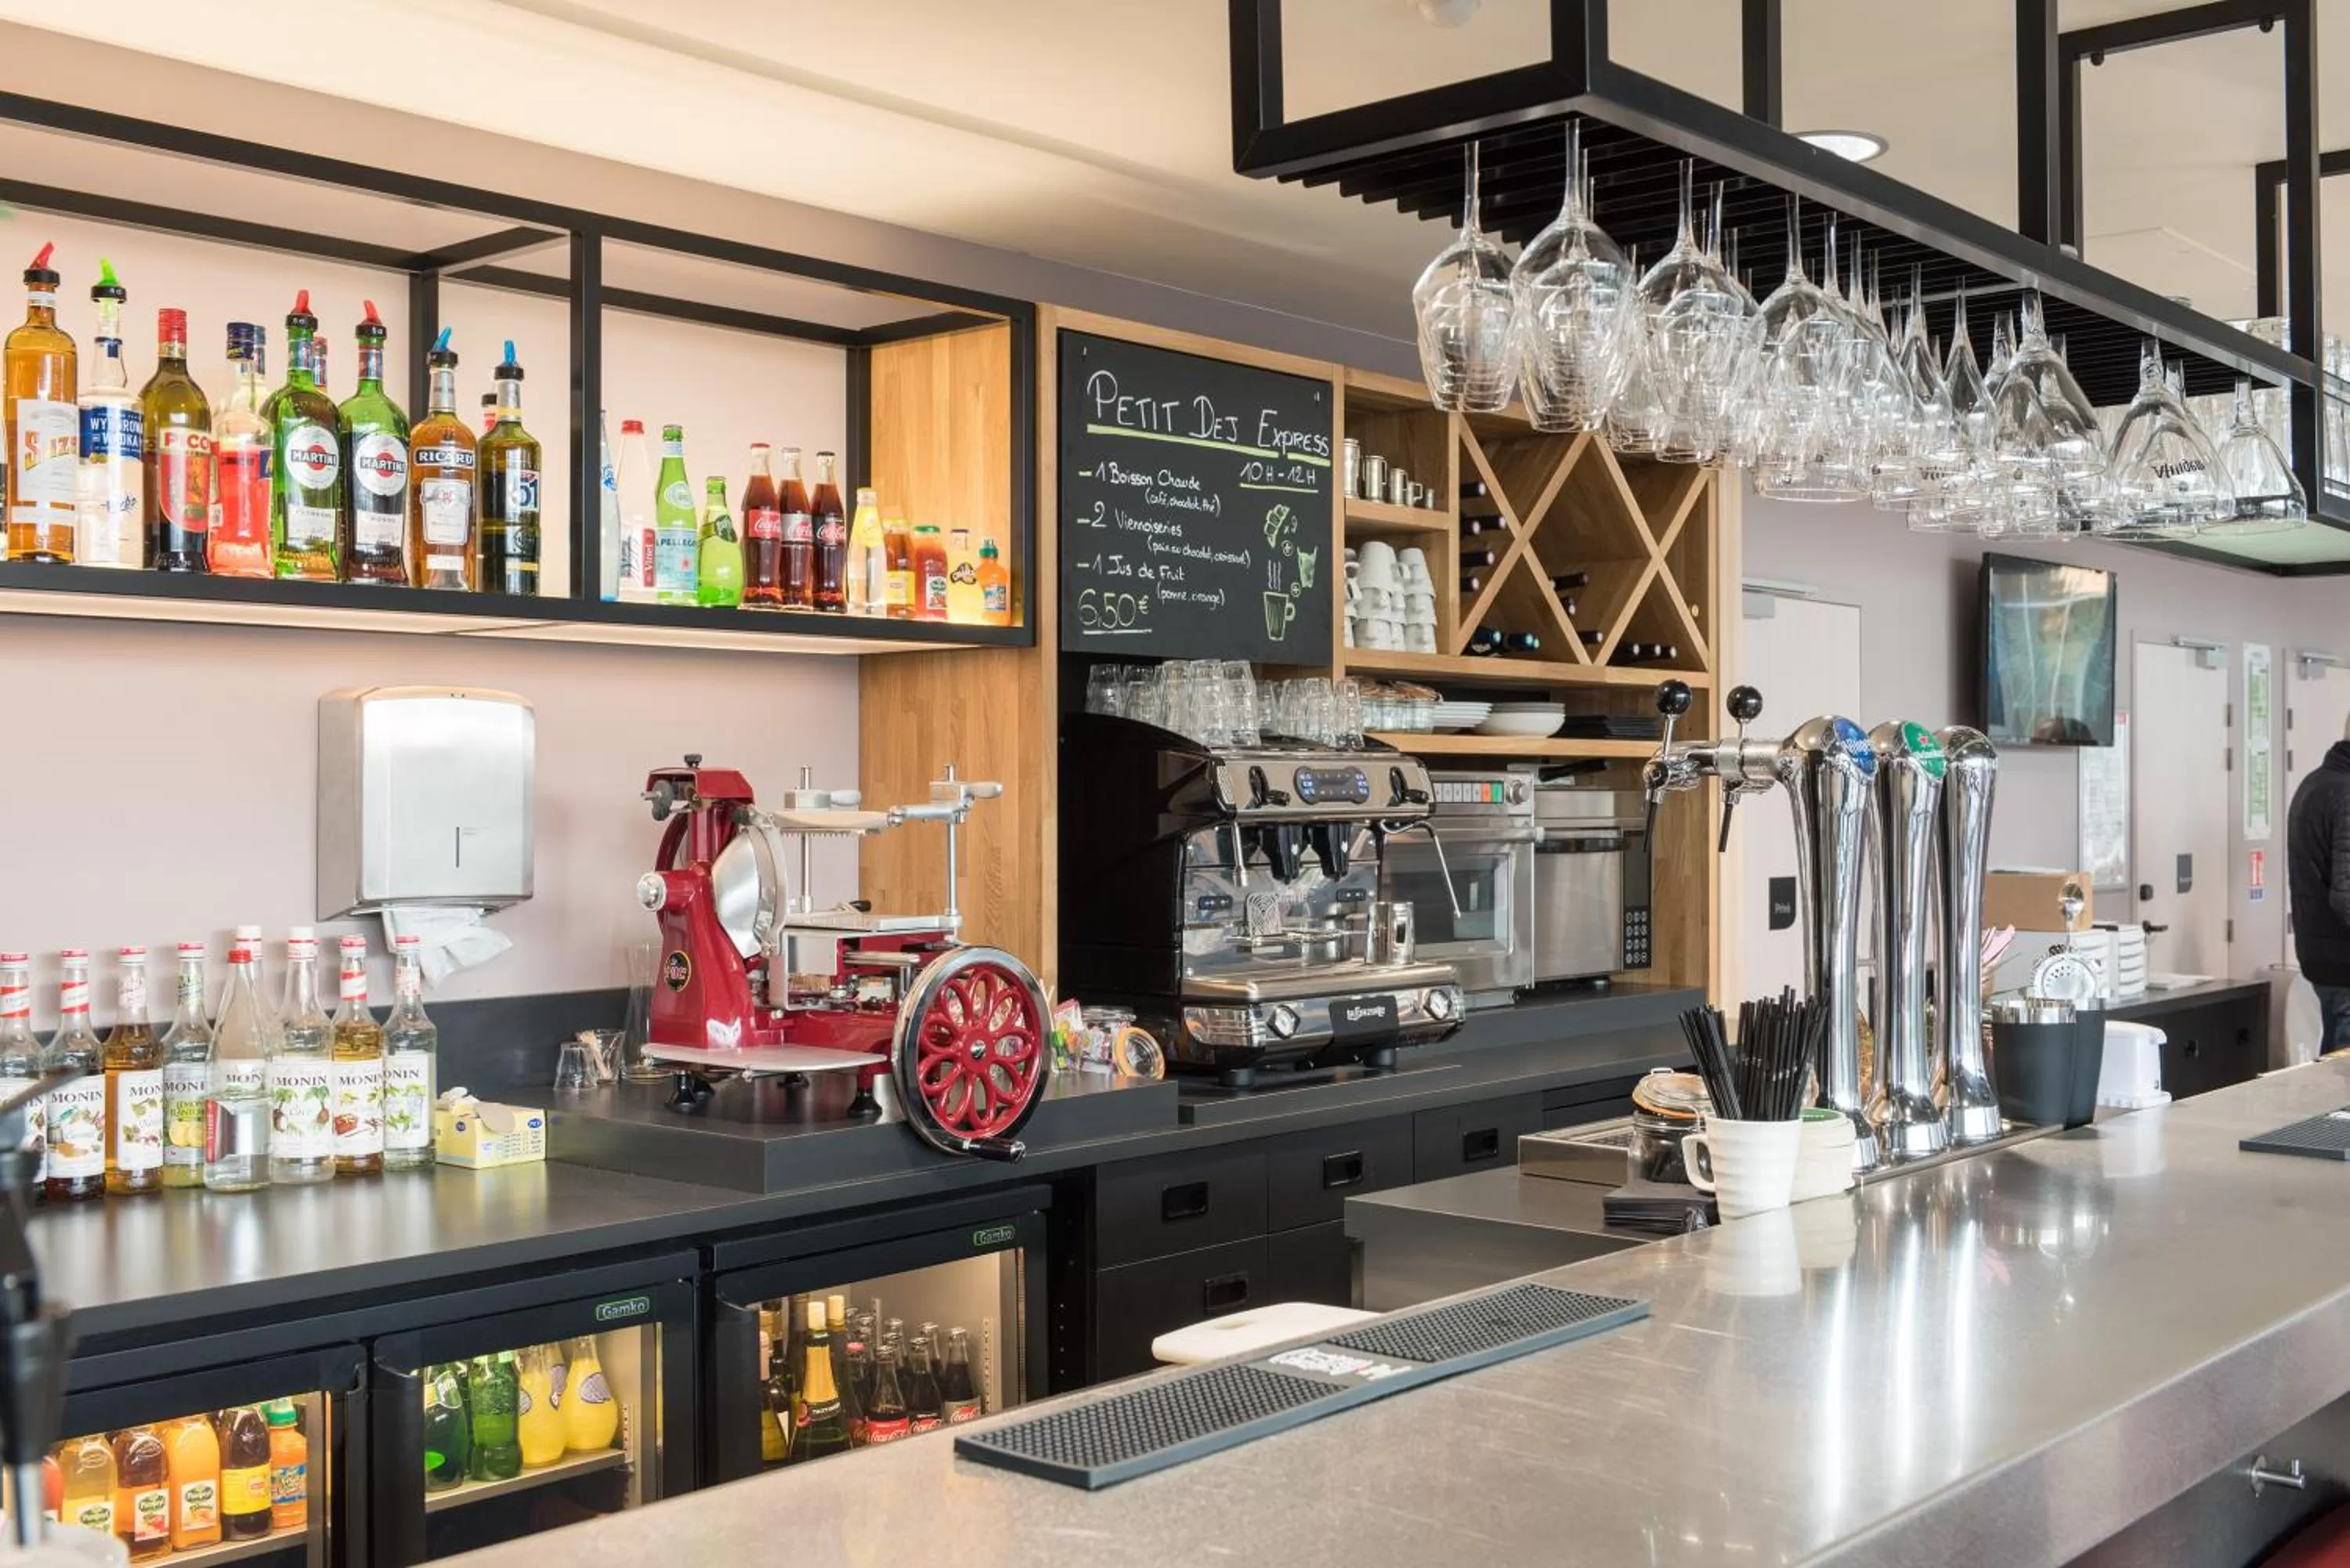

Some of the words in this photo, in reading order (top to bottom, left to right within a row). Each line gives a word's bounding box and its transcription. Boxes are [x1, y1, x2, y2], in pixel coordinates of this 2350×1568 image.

[1188, 395, 1238, 443] DEJ
[103, 432, 139, 447] VDKA
[291, 450, 337, 466] MARTINI
[1108, 461, 1153, 486] Boisson
[1158, 469, 1202, 490] Chaude
[1107, 555, 1132, 576] Jus
[1138, 562, 1155, 580] de
[1159, 565, 1185, 581] Fruit
[277, 1076, 327, 1086] MONIN
[340, 1074, 381, 1085] MONI
[52, 1090, 103, 1104] MONIN
[602, 1301, 645, 1317] Gamko
